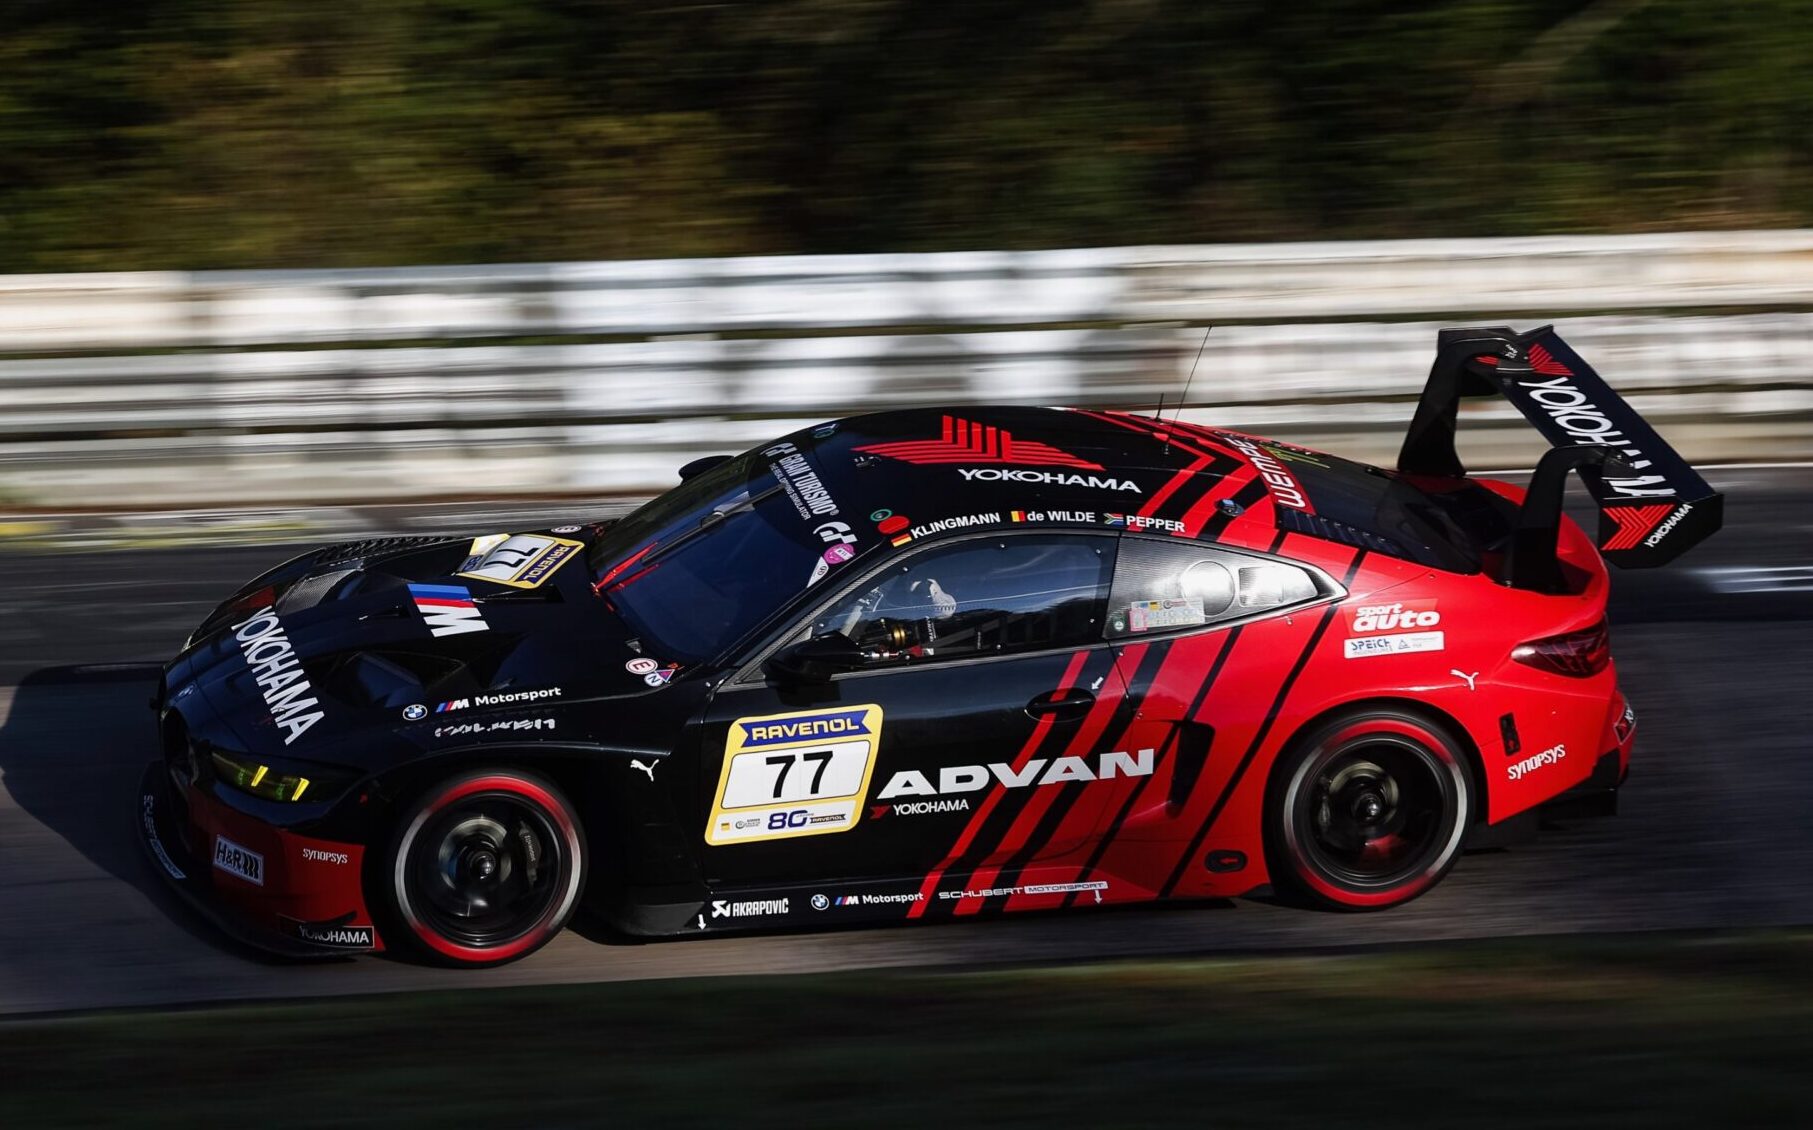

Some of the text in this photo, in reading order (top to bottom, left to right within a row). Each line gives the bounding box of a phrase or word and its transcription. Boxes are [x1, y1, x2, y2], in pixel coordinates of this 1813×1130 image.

[778, 453, 812, 476] GRAN
[1223, 437, 1306, 508] WEMPE
[958, 468, 1142, 493] YOKOHAMA
[911, 512, 1001, 539] KLINGMANN
[1026, 510, 1097, 523] de WILDE
[1125, 515, 1187, 533] PEPPER
[1643, 503, 1693, 548] YOKOHAMA
[523, 546, 571, 580] RAVENOL
[1352, 610, 1441, 632] auto
[1356, 603, 1403, 616] sport
[230, 605, 325, 746] YOKOHAMA
[474, 687, 562, 707] Motorsport
[751, 718, 860, 741] RAVENOL
[765, 750, 834, 799] 77
[876, 748, 1155, 800] ADVAN
[892, 799, 969, 816] YOKOHAMA
[767, 809, 808, 830] 80
[862, 892, 924, 905] Motorsport
[938, 883, 1105, 900] SCHUBERT MOTORSPORT
